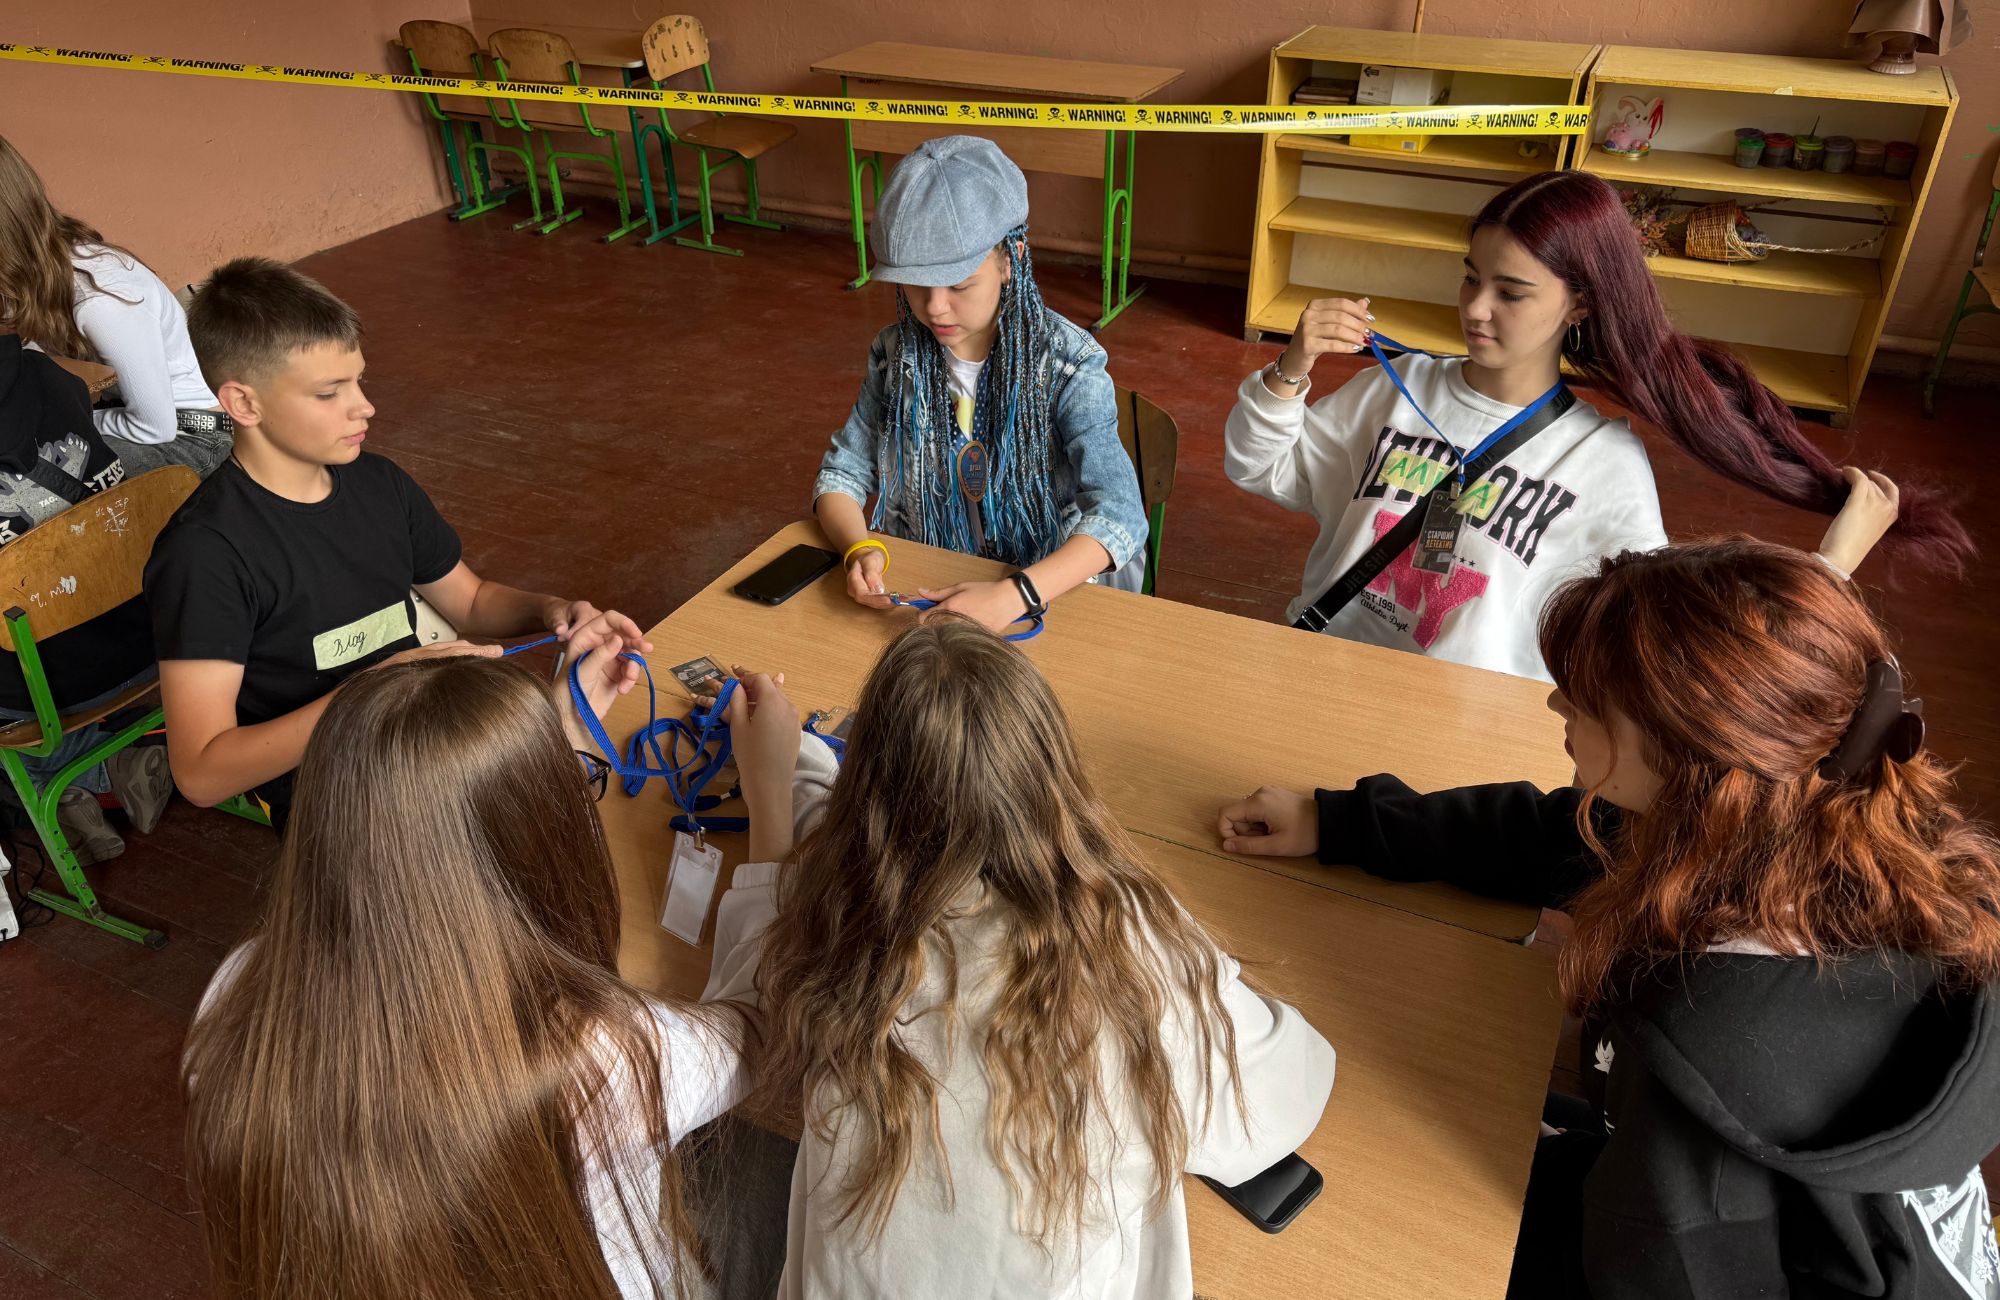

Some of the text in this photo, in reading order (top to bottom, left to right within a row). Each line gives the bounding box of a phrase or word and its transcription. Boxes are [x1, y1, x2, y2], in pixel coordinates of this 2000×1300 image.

[56, 48, 134, 62] WARNING!
[171, 58, 246, 72] WARNING!
[282, 67, 355, 80] WARNING!
[391, 75, 461, 88] WARNING!
[496, 83, 563, 95] WARNING!
[598, 89, 664, 101] WARNING!
[696, 94, 761, 107] WARNING!
[793, 99, 856, 112] WARNING!
[887, 103, 948, 116] WARNING!
[979, 106, 1038, 120] WARNING!
[1067, 108, 1126, 122] WARNING!
[1154, 110, 1212, 124] WARNING!
[1240, 111, 1296, 127] WARNING!
[1323, 112, 1379, 127] WARNING!
[1406, 113, 1459, 128] WARNING!
[1486, 114, 1538, 128] WARNING!
